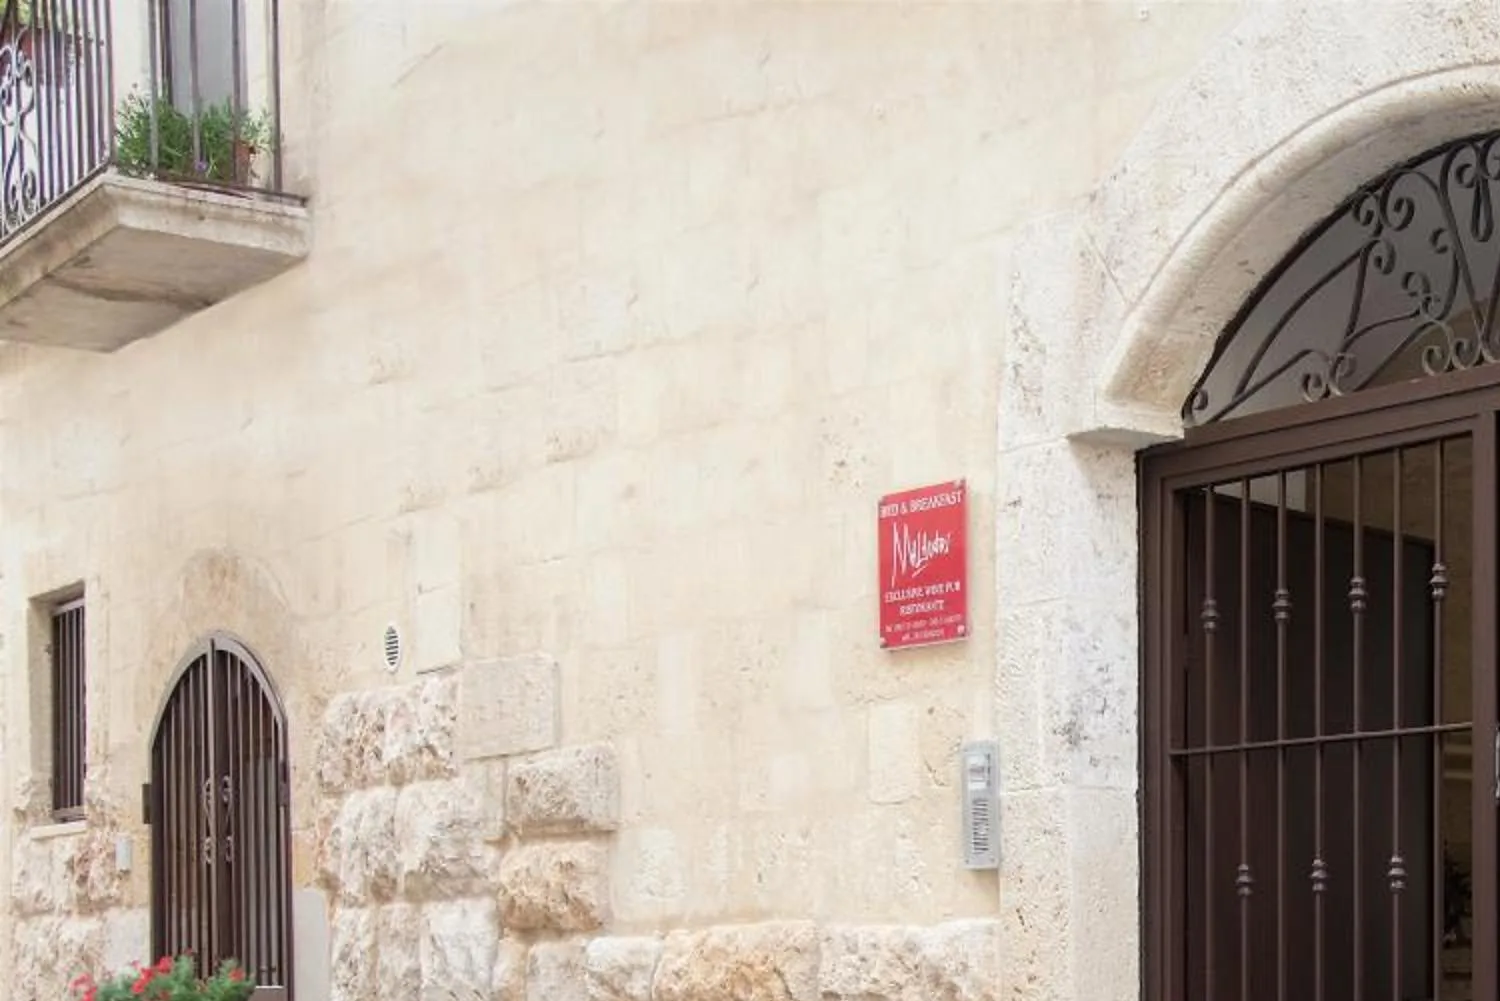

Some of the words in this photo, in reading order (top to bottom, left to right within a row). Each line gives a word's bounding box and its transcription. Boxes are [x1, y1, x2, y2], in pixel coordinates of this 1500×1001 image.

[880, 504, 899, 518] BED
[900, 501, 908, 514] &
[910, 491, 962, 513] BREAKFAST
